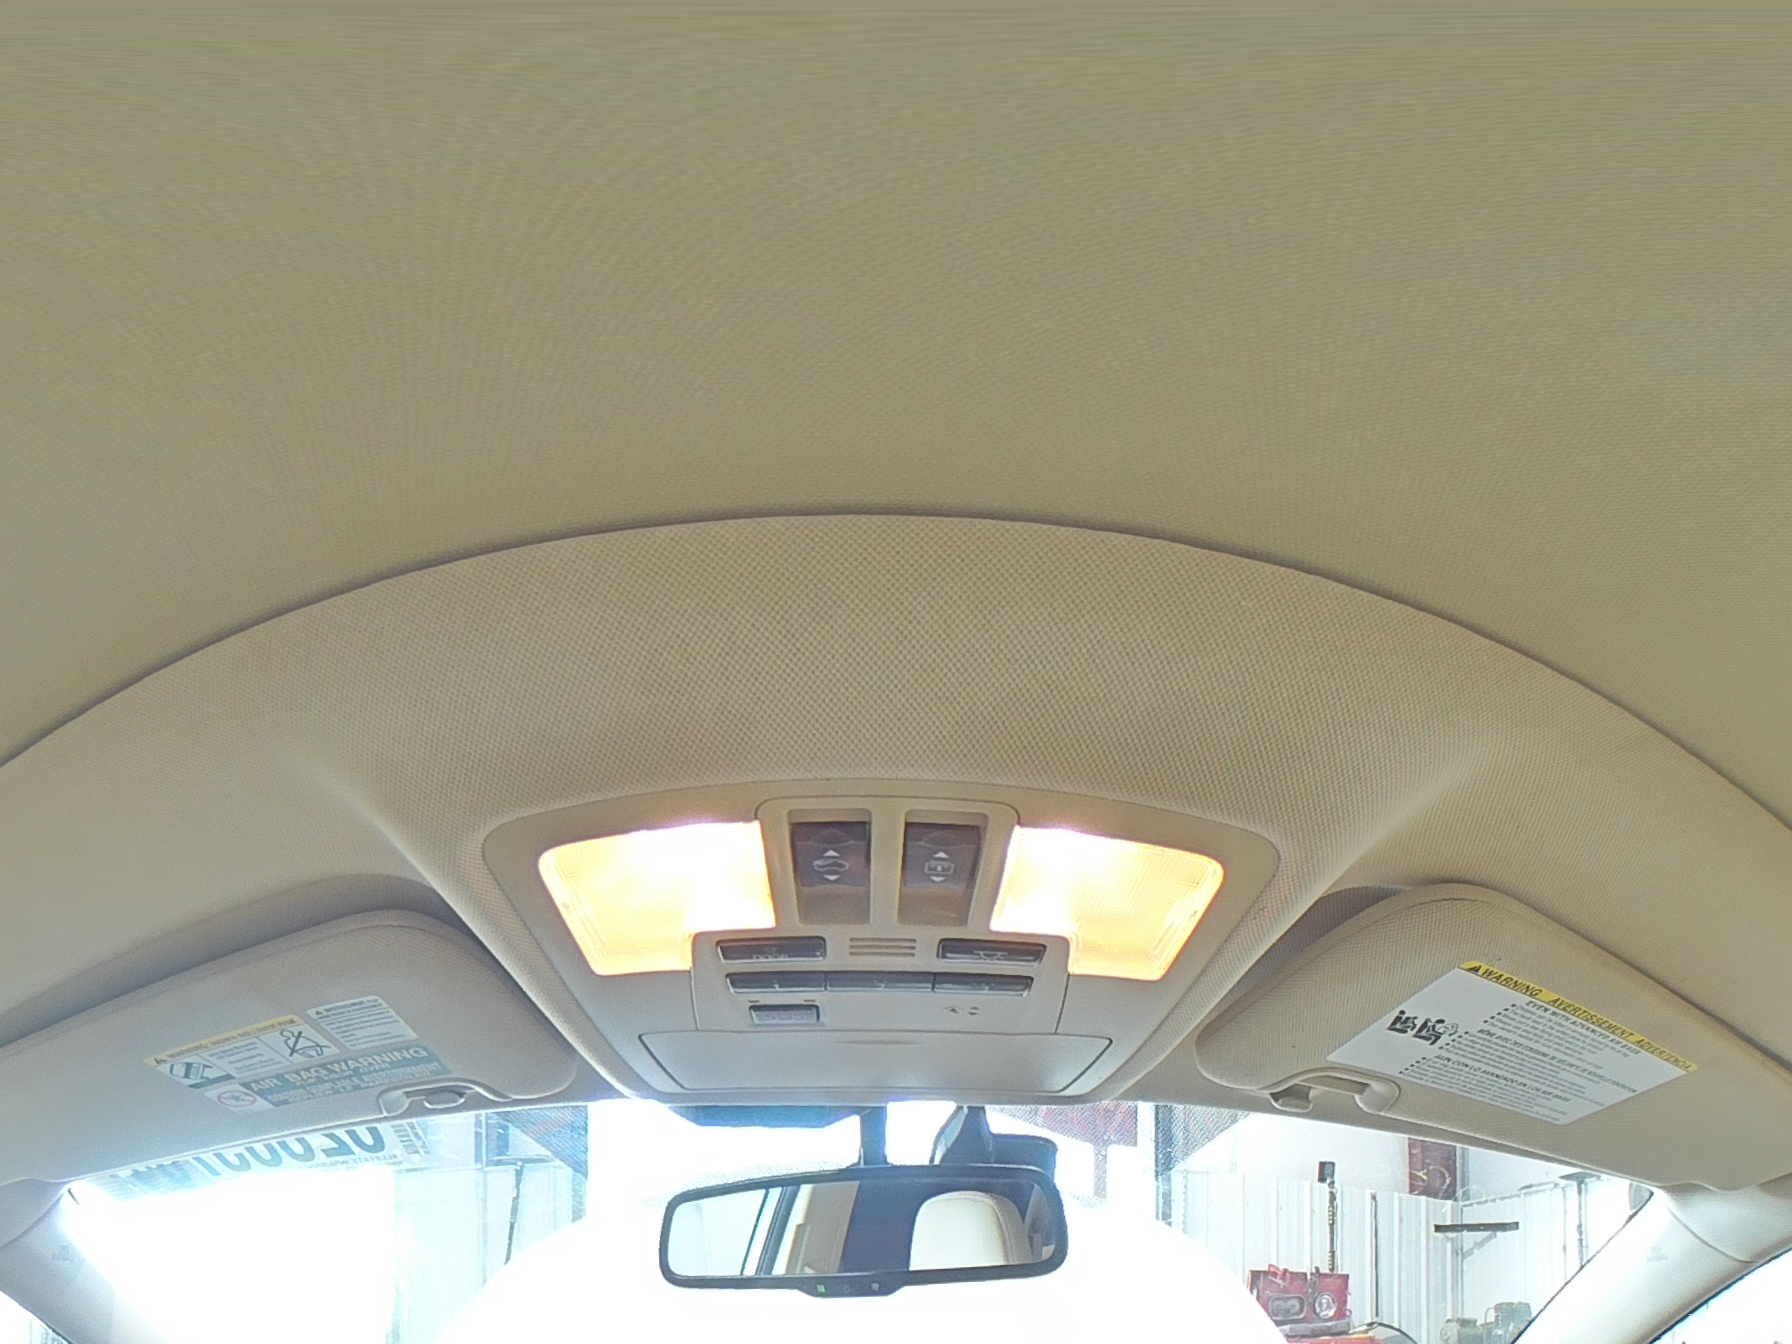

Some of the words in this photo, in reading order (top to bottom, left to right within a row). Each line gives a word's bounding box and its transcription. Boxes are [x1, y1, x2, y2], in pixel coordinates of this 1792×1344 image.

[1481, 968, 1543, 997] WARNING
[250, 1078, 283, 1091] AIR
[284, 1067, 329, 1083] BAG
[325, 1047, 429, 1073] WARNING
